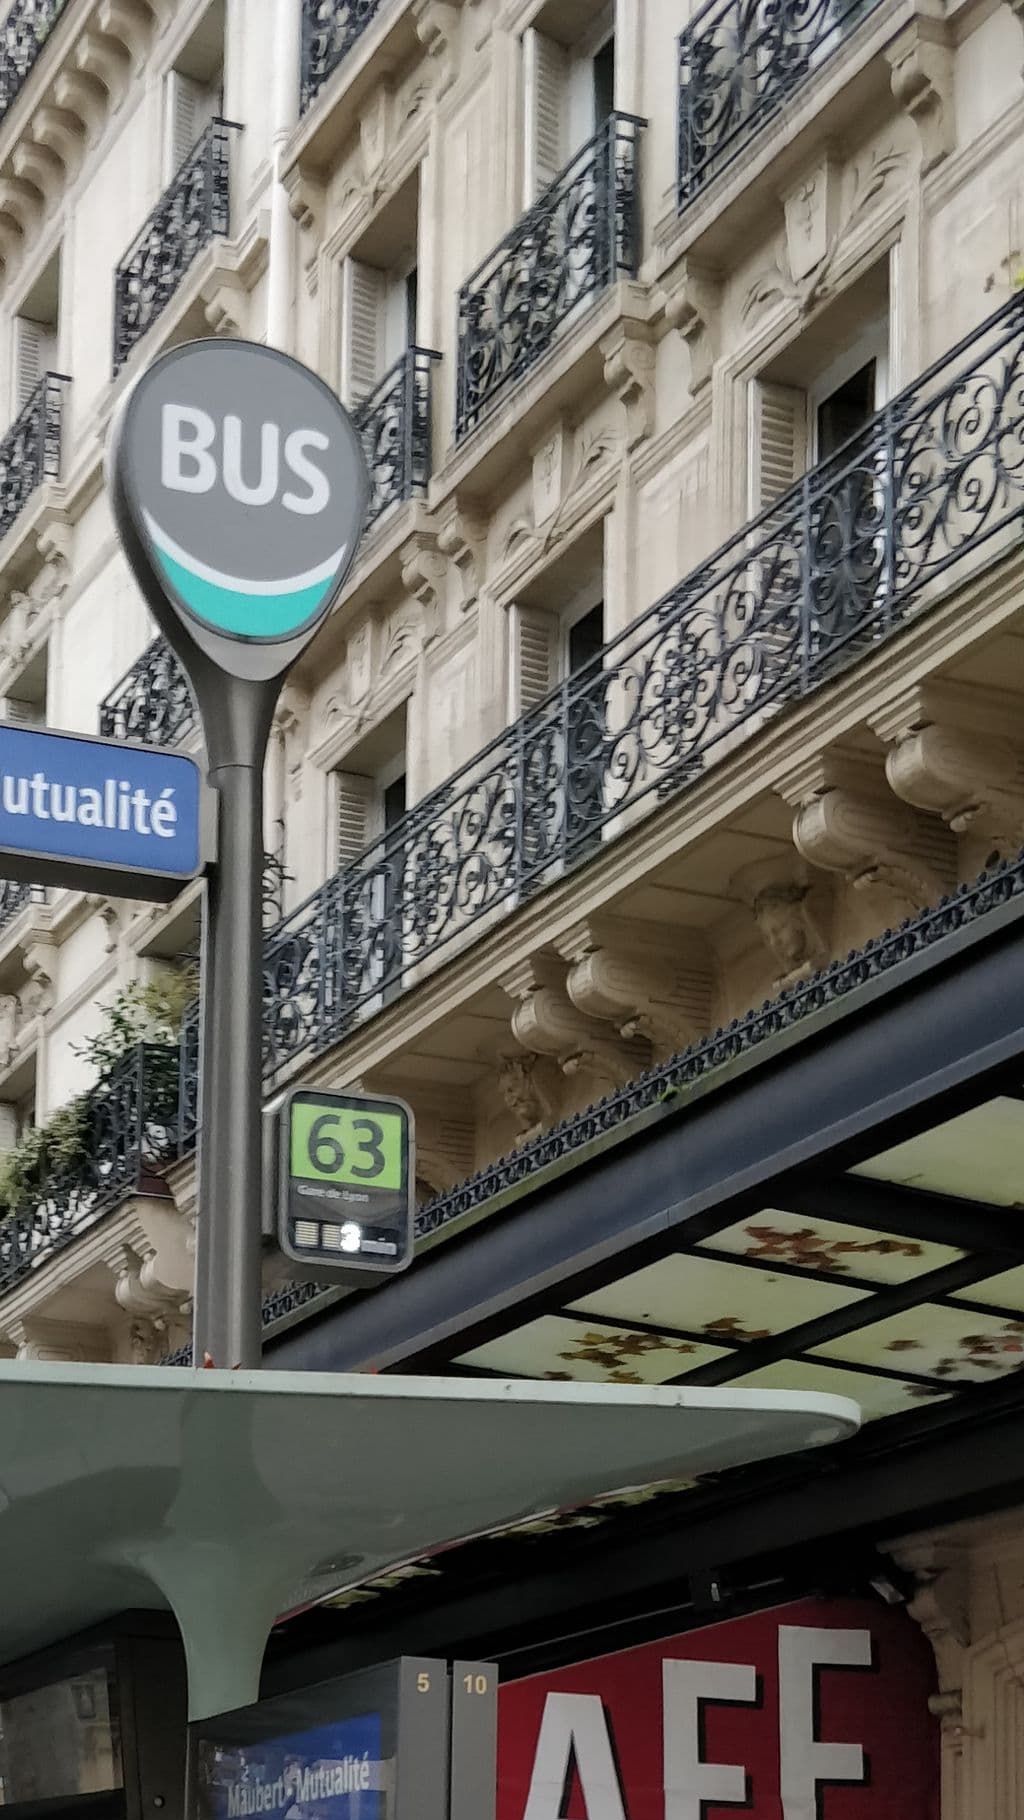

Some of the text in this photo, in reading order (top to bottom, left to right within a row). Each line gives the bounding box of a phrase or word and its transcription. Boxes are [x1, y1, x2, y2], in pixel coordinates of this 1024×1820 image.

[160, 402, 333, 516] BUS
[307, 1113, 386, 1179] 63
[416, 1672, 430, 1693] 5
[463, 1674, 488, 1695] 10
[227, 1776, 286, 1819] Maubert
[295, 1751, 370, 1803] Mutualité
